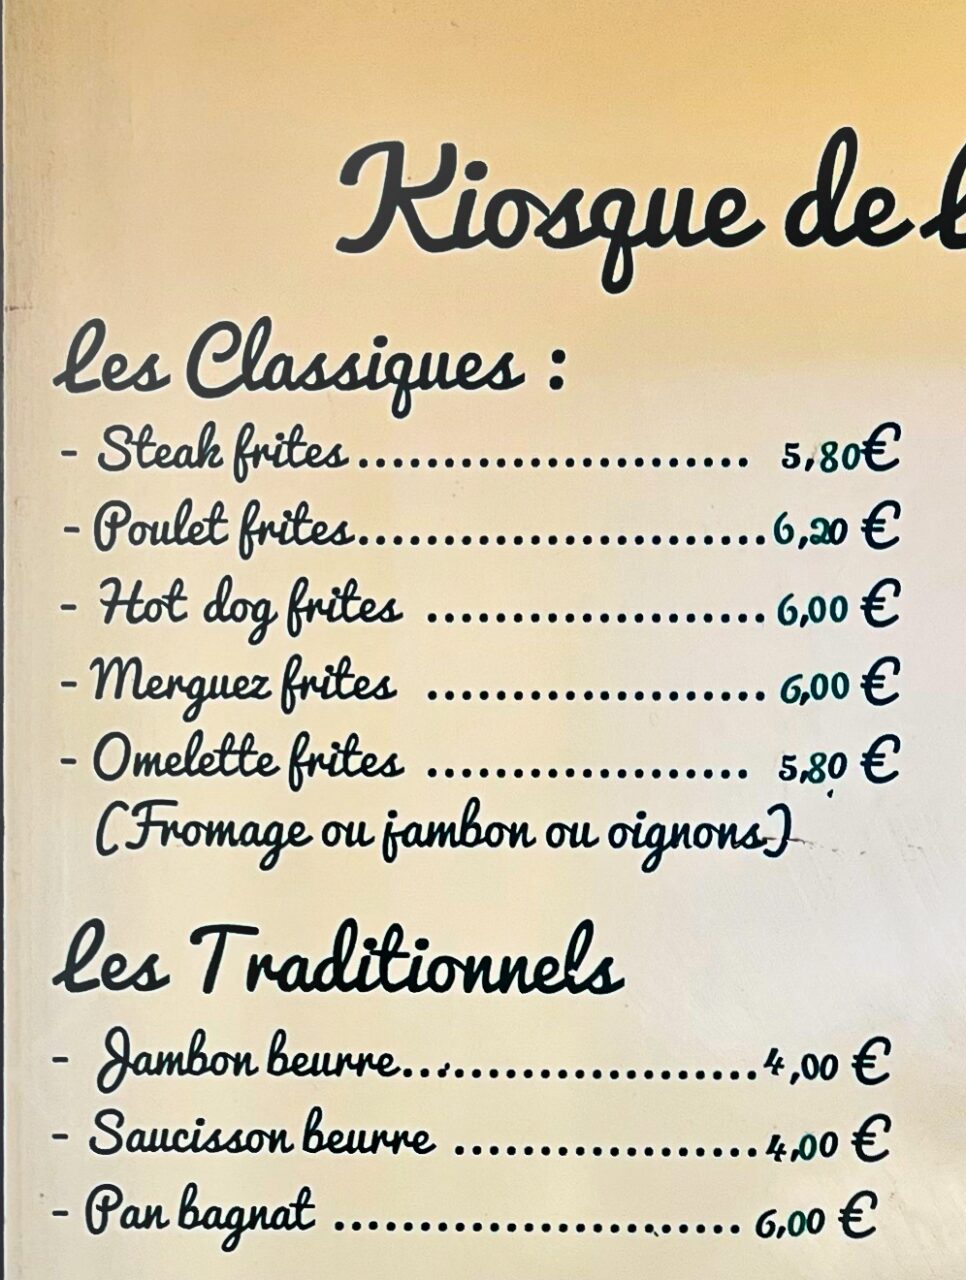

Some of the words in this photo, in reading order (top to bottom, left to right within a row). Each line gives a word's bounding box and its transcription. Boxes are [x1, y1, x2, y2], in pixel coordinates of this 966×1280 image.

[335, 140, 766, 295] Kiosque
[784, 126, 913, 248] de
[186, 315, 526, 420] Classiques
[97, 420, 224, 472] Steak
[233, 422, 350, 484] frites
[781, 421, 902, 474] 5,80€
[93, 497, 229, 552] Poulet
[238, 499, 356, 561] frites
[773, 511, 849, 550] 6,20
[99, 576, 188, 625] Hot
[203, 574, 279, 646] dog
[286, 576, 404, 638] frites
[777, 592, 849, 629] 6,00
[89, 656, 273, 723] Merguez
[280, 653, 398, 715] frites
[780, 671, 850, 707] 6,00
[93, 728, 281, 782] Omelette
[288, 730, 406, 793] frites
[778, 751, 848, 785] 5,80
[95, 798, 314, 872] (Fromage
[321, 820, 376, 848] ou
[381, 796, 537, 864] jambon
[545, 821, 600, 849] ou
[607, 802, 796, 874] oignons)
[189, 917, 626, 995] Traditionnels
[96, 1025, 260, 1095] Jambon
[266, 1028, 402, 1078] beurre
[762, 1047, 839, 1086] 4,00
[88, 1108, 295, 1156] Saucisson
[302, 1105, 438, 1155] beurre
[765, 1131, 839, 1163] 4,00
[84, 1183, 171, 1236] Pan
[177, 1181, 316, 1253] bagnat
[755, 1207, 826, 1240] 6,00
